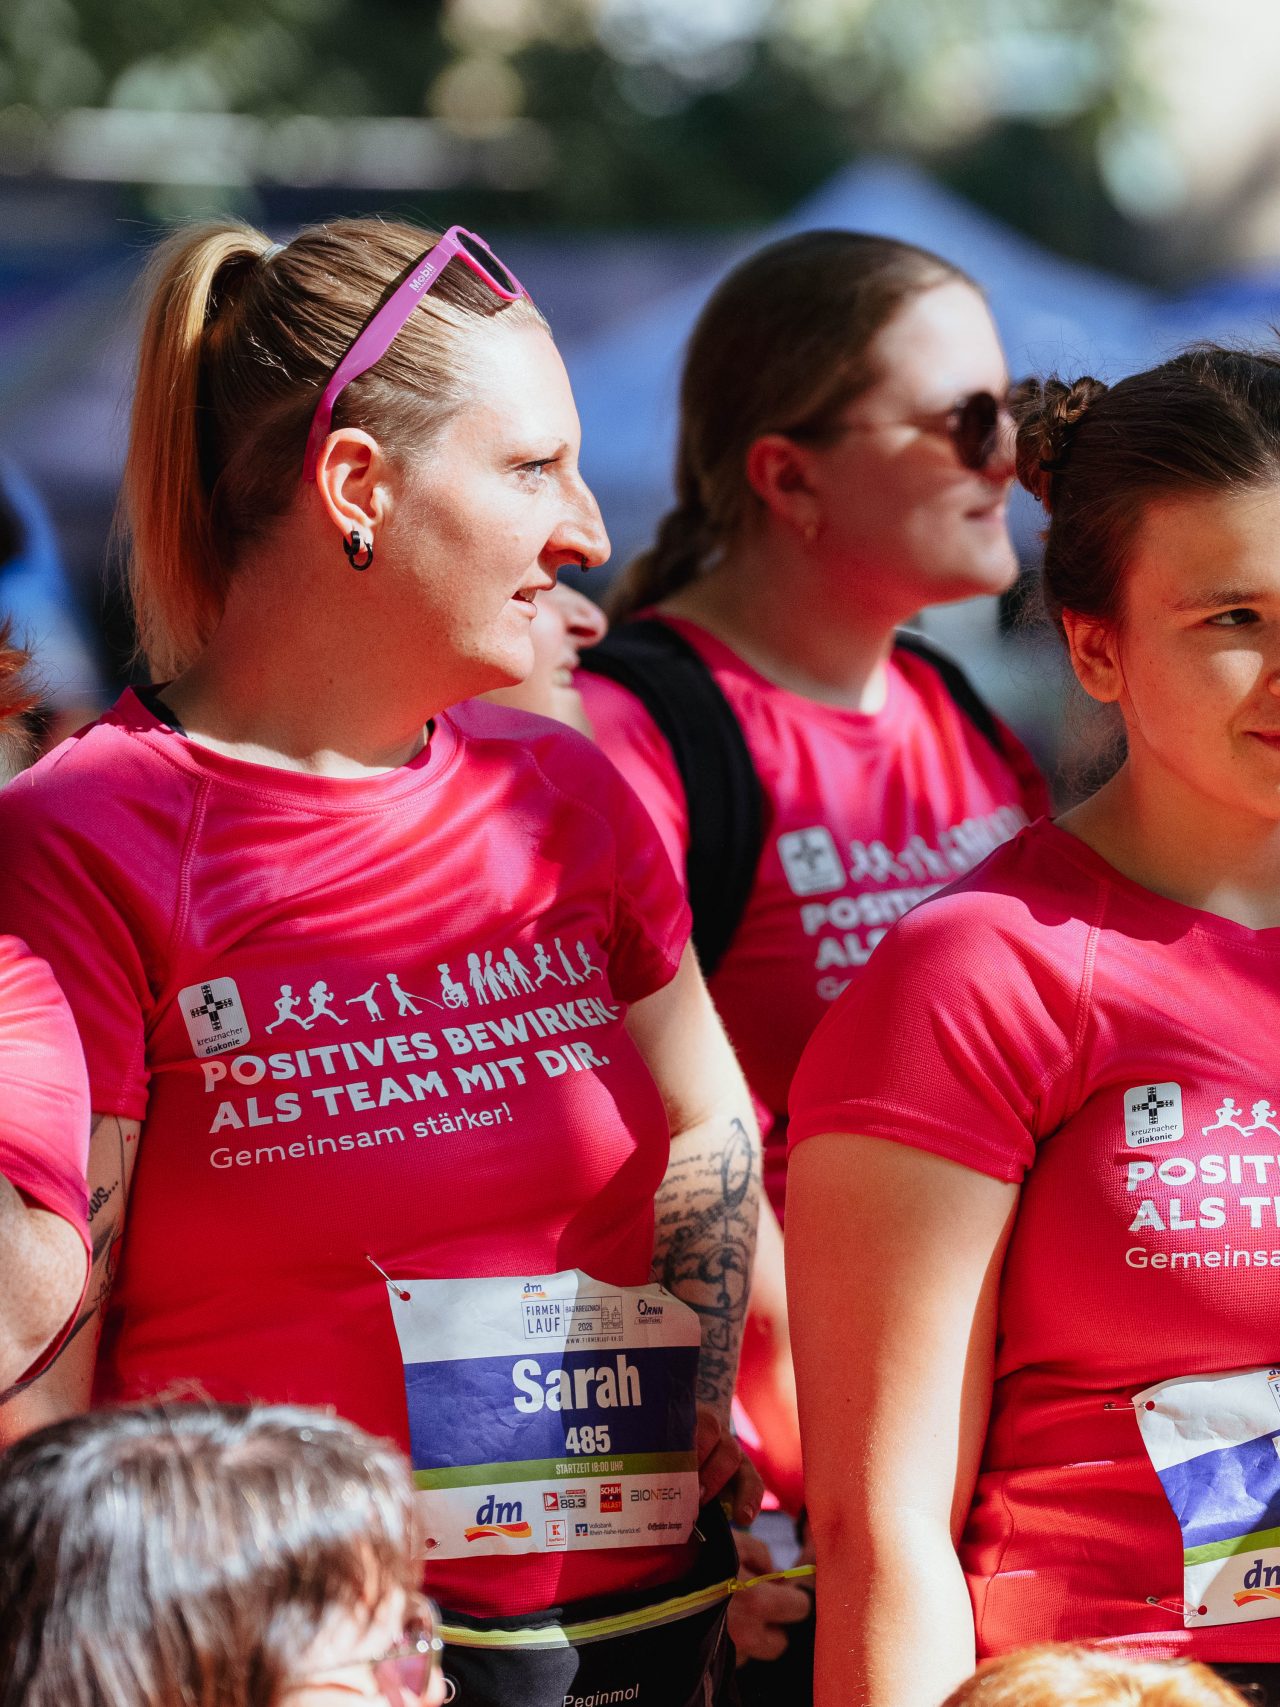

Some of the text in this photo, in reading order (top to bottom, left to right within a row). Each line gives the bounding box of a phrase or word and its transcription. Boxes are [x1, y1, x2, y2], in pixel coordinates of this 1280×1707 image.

[409, 262, 434, 291] Mobil
[196, 1027, 243, 1046] kreuznacher
[205, 1038, 241, 1055] diakonie
[200, 1033, 438, 1093] POSITIVES
[208, 1041, 611, 1134] ALS TEAM MIT DIR.
[209, 1101, 514, 1169] Gemeinsam stärker!
[1131, 1123, 1178, 1136] kreuznacher
[1136, 1132, 1173, 1144] diakonie
[1128, 1197, 1226, 1232] ALS
[523, 1283, 543, 1293] dm
[526, 1304, 560, 1316] FIRMEN
[527, 1317, 561, 1334] LAUF
[512, 1354, 642, 1414] Sarah
[565, 1425, 611, 1454] 485
[555, 1460, 624, 1475] STARTZEIT 18:00 UHR
[600, 1486, 620, 1495] SCHUH
[630, 1488, 682, 1501] BIONTECH
[476, 1495, 523, 1525] dm
[560, 1499, 586, 1508] 88.3
[562, 1683, 640, 1707] Peginmol
